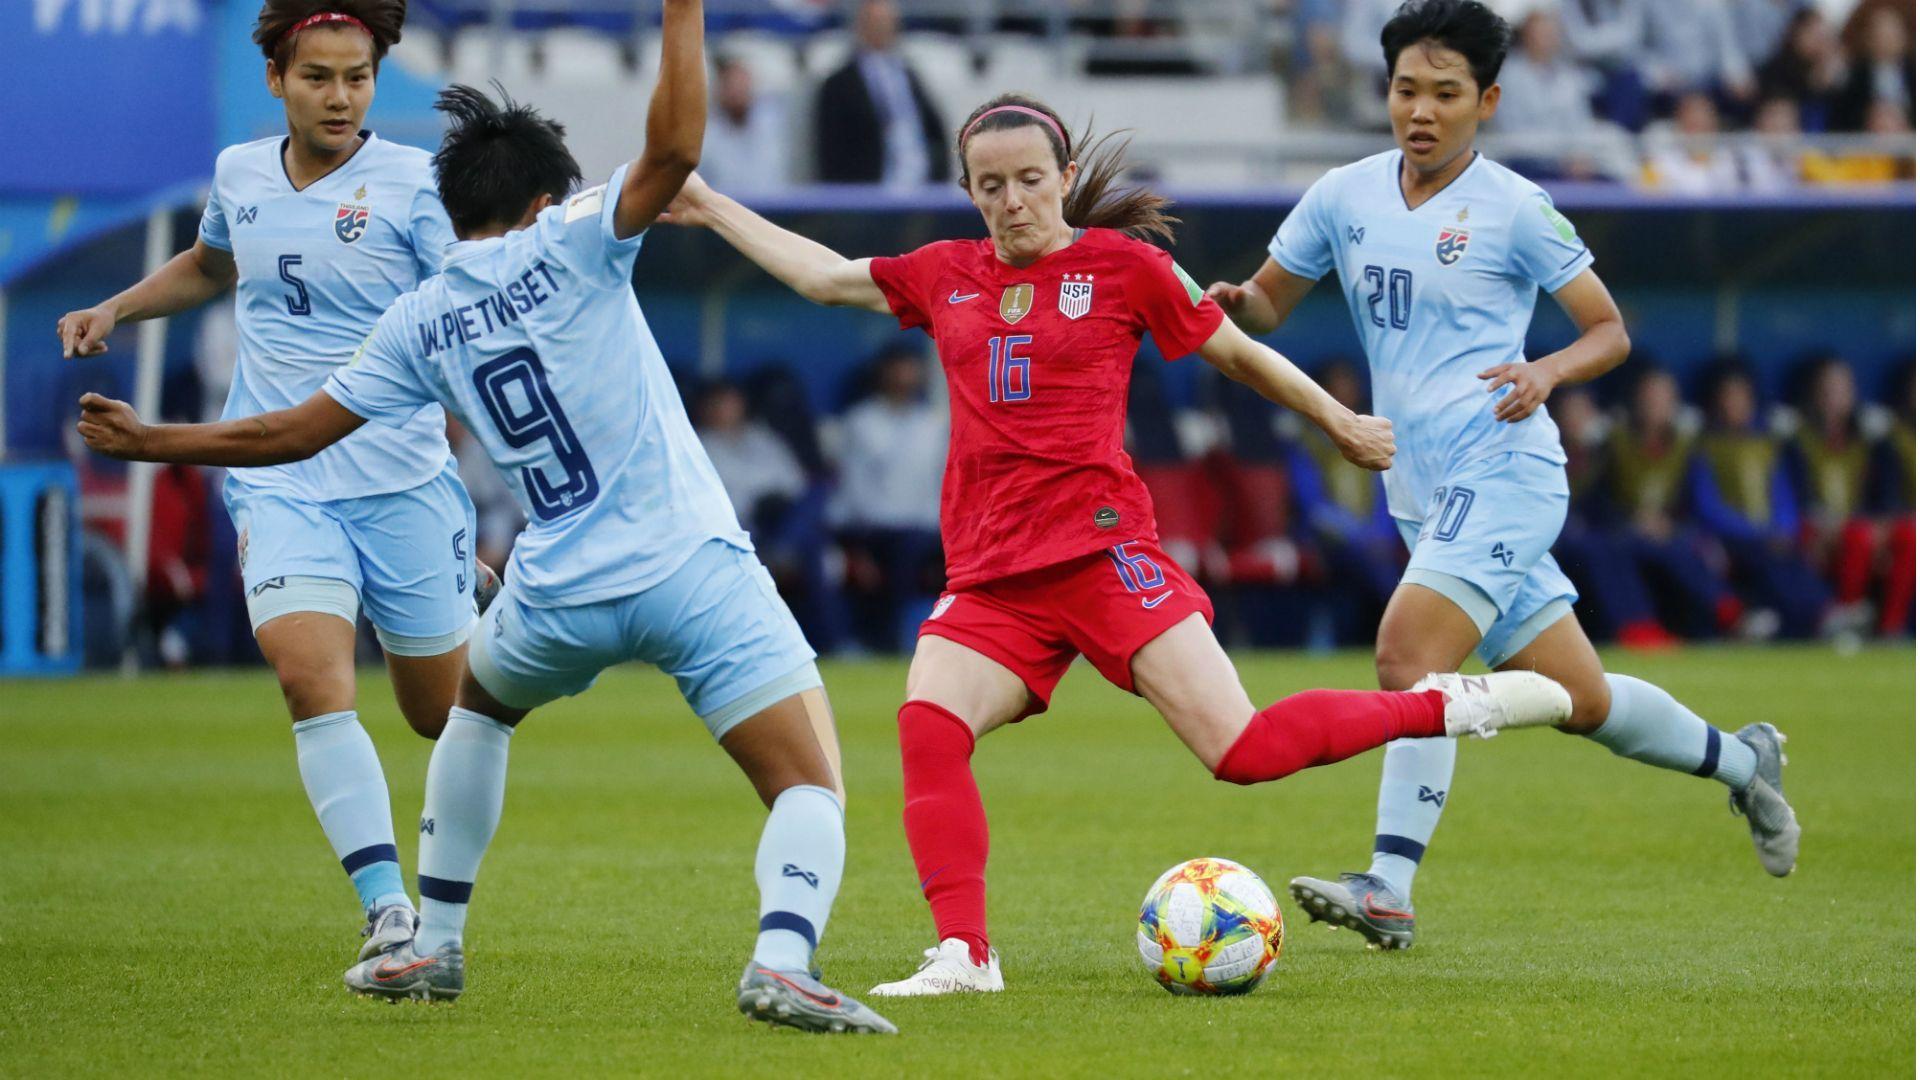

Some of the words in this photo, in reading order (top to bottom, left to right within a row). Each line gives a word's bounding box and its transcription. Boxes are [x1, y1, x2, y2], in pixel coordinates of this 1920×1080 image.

[278, 254, 311, 315] 5
[1063, 284, 1090, 298] USA
[1364, 264, 1412, 331] 20
[988, 334, 1032, 402] 16
[473, 346, 600, 521] 9
[452, 527, 467, 594] 5
[1108, 540, 1165, 592] 16
[921, 976, 951, 990] new
